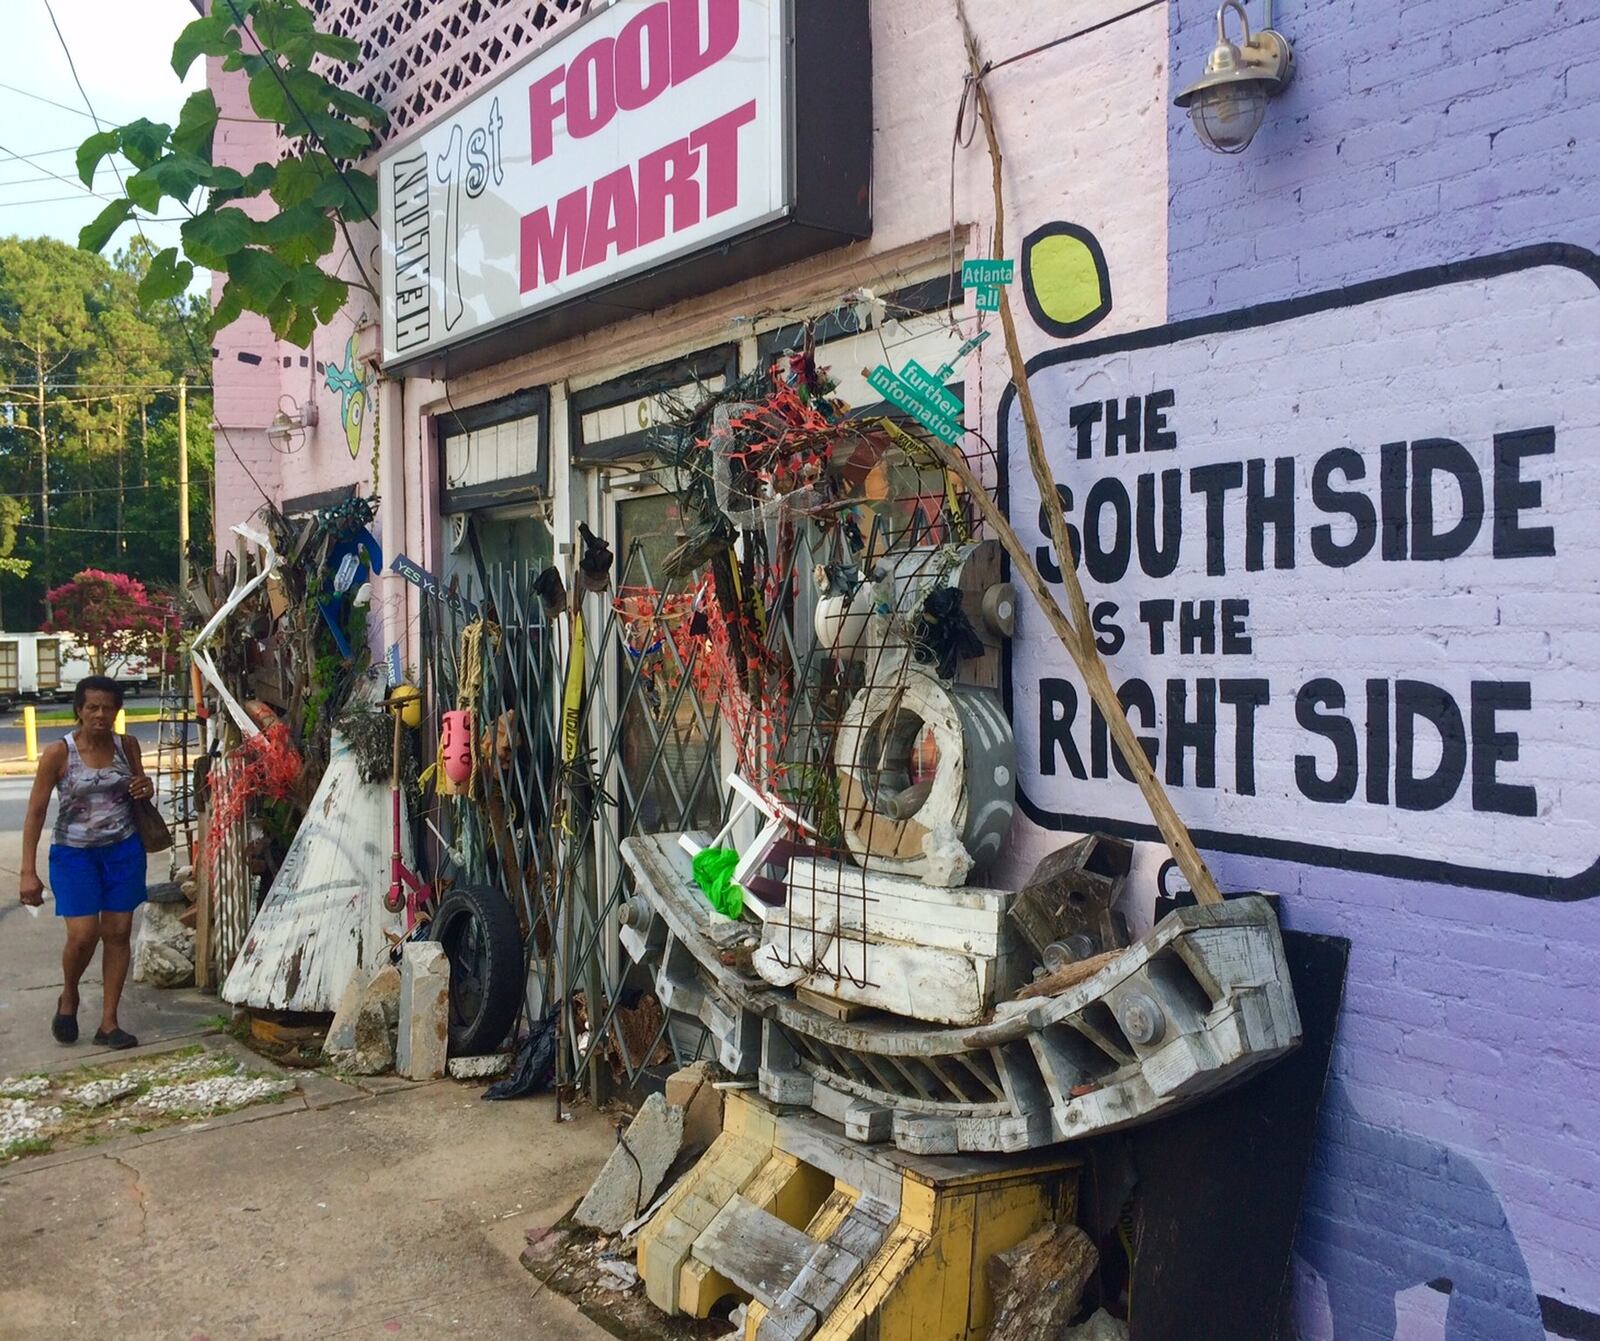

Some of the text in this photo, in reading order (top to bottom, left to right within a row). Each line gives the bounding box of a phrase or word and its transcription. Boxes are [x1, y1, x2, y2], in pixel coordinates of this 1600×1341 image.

[528, 0, 740, 166] FOOD
[519, 98, 757, 295] MART
[393, 151, 431, 352] HEALTHY
[963, 266, 1013, 284] Atlanta
[976, 289, 998, 307] all
[872, 370, 963, 444] information
[904, 366, 958, 417] further
[1069, 389, 1177, 460] THE
[397, 561, 421, 583] YES
[1140, 599, 1253, 656] THE
[1039, 678, 1538, 818] RIGHT SIDE
